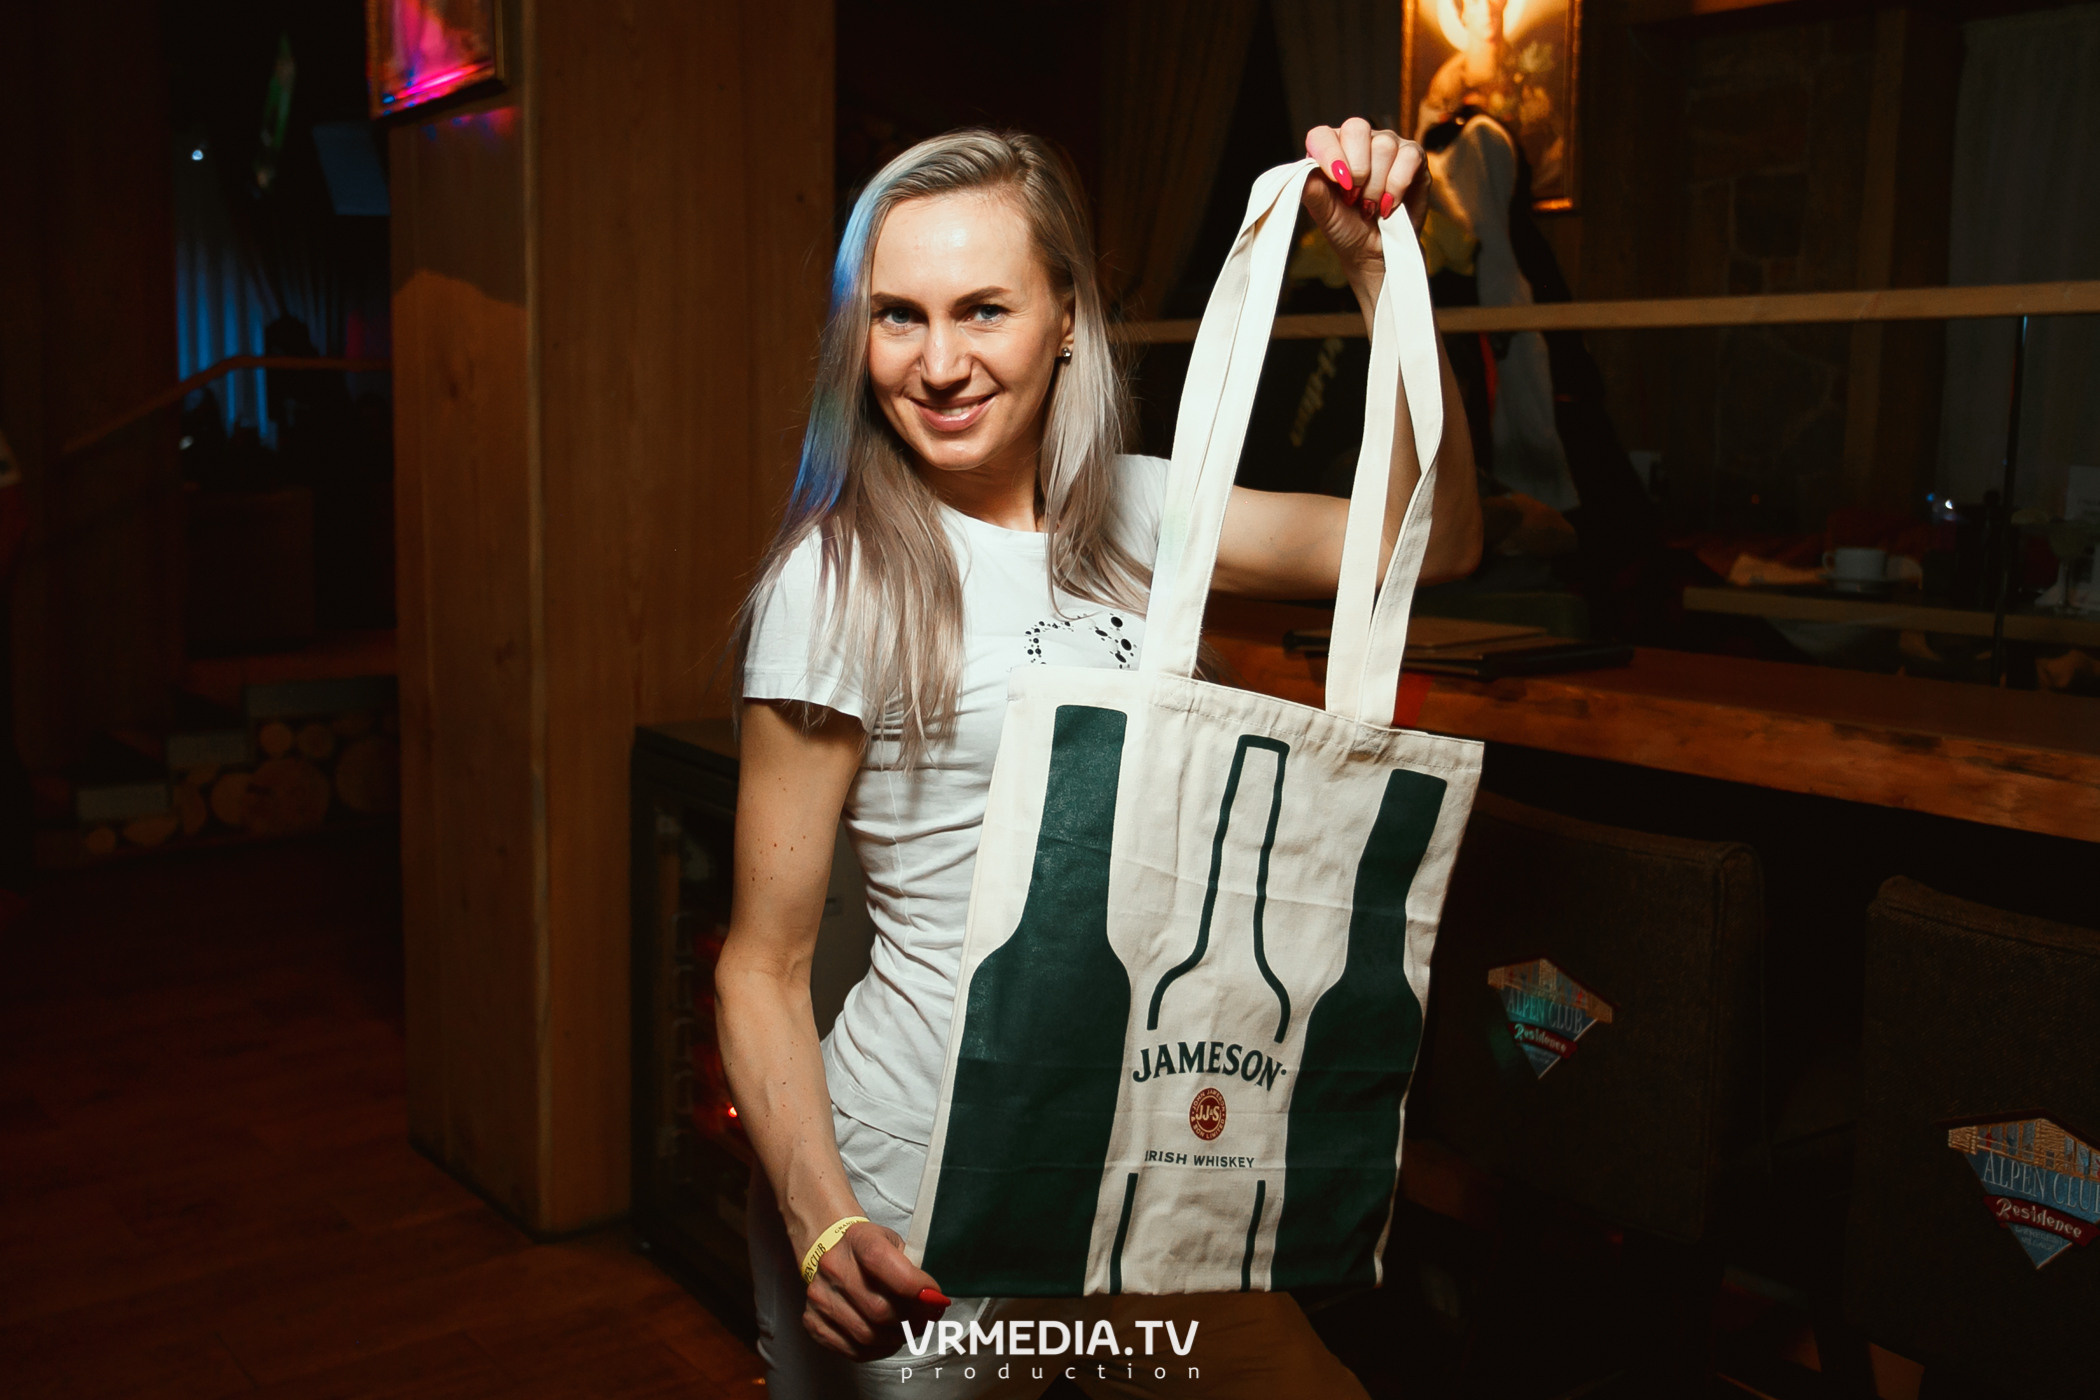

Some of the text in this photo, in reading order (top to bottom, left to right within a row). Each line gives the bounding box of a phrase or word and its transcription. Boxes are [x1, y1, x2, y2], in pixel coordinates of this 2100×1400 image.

[1506, 988, 1583, 1035] ALPEN CLUB
[1514, 1023, 1568, 1053] Residence
[1132, 1041, 1284, 1092] JAMESON
[1144, 1150, 1256, 1169] IRISH WHISKEY
[1980, 1150, 2047, 1201] ALPEN
[1995, 1197, 2083, 1239] Residence
